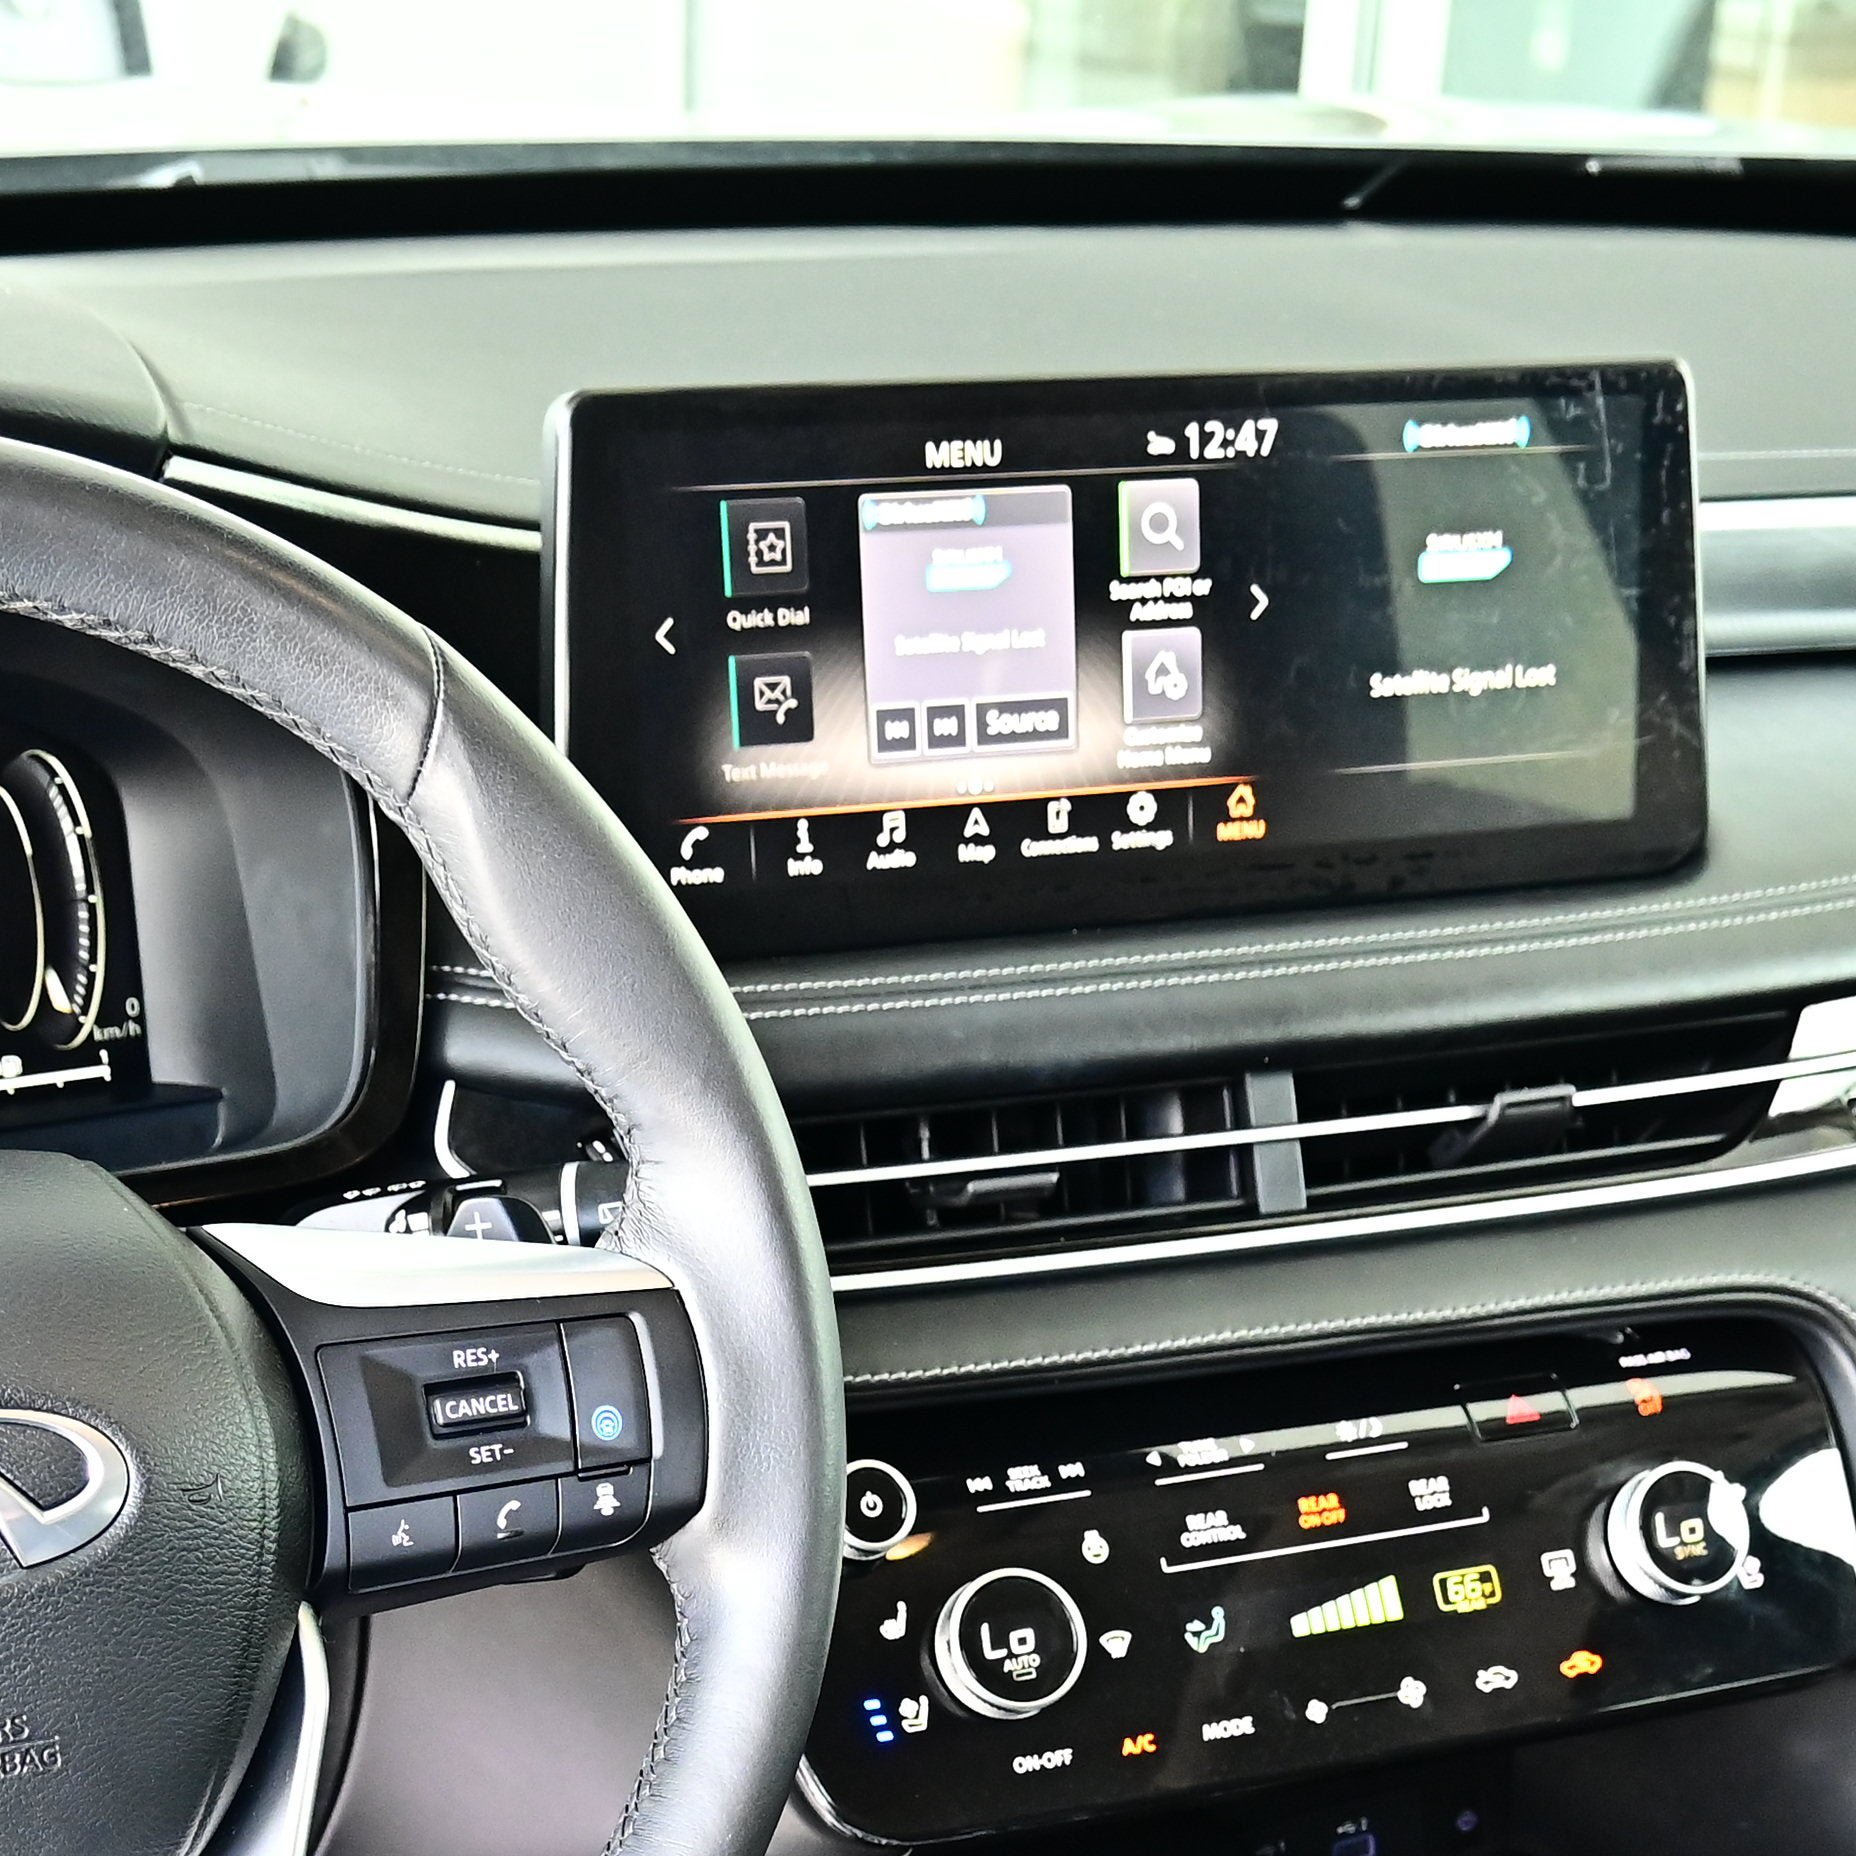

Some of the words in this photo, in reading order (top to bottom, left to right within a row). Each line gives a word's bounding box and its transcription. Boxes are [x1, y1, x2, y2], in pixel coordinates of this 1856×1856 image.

[1184, 418, 1279, 461] 12:47
[924, 439, 1003, 470] MENU
[726, 608, 775, 632] Quick
[777, 606, 810, 627] Dial
[1369, 669, 1450, 698] Satellite
[1452, 663, 1513, 696] Signal
[1515, 664, 1556, 688] Lost
[985, 708, 1061, 738] Source
[721, 762, 758, 784] Text
[1110, 828, 1174, 853] Settings
[1216, 819, 1266, 843] MENU
[786, 854, 824, 877] Info
[865, 847, 917, 872] Audio
[957, 843, 996, 866] Map
[669, 864, 725, 887] Phone
[93, 1018, 142, 1042] km/h
[451, 1347, 500, 1369] RES+
[444, 1393, 520, 1420] CANCEL
[1180, 1524, 1247, 1549] CONTROL
[1003, 1653, 1042, 1674] AUTO
[1201, 1715, 1256, 1742] MODE
[1121, 1732, 1158, 1757] A/C
